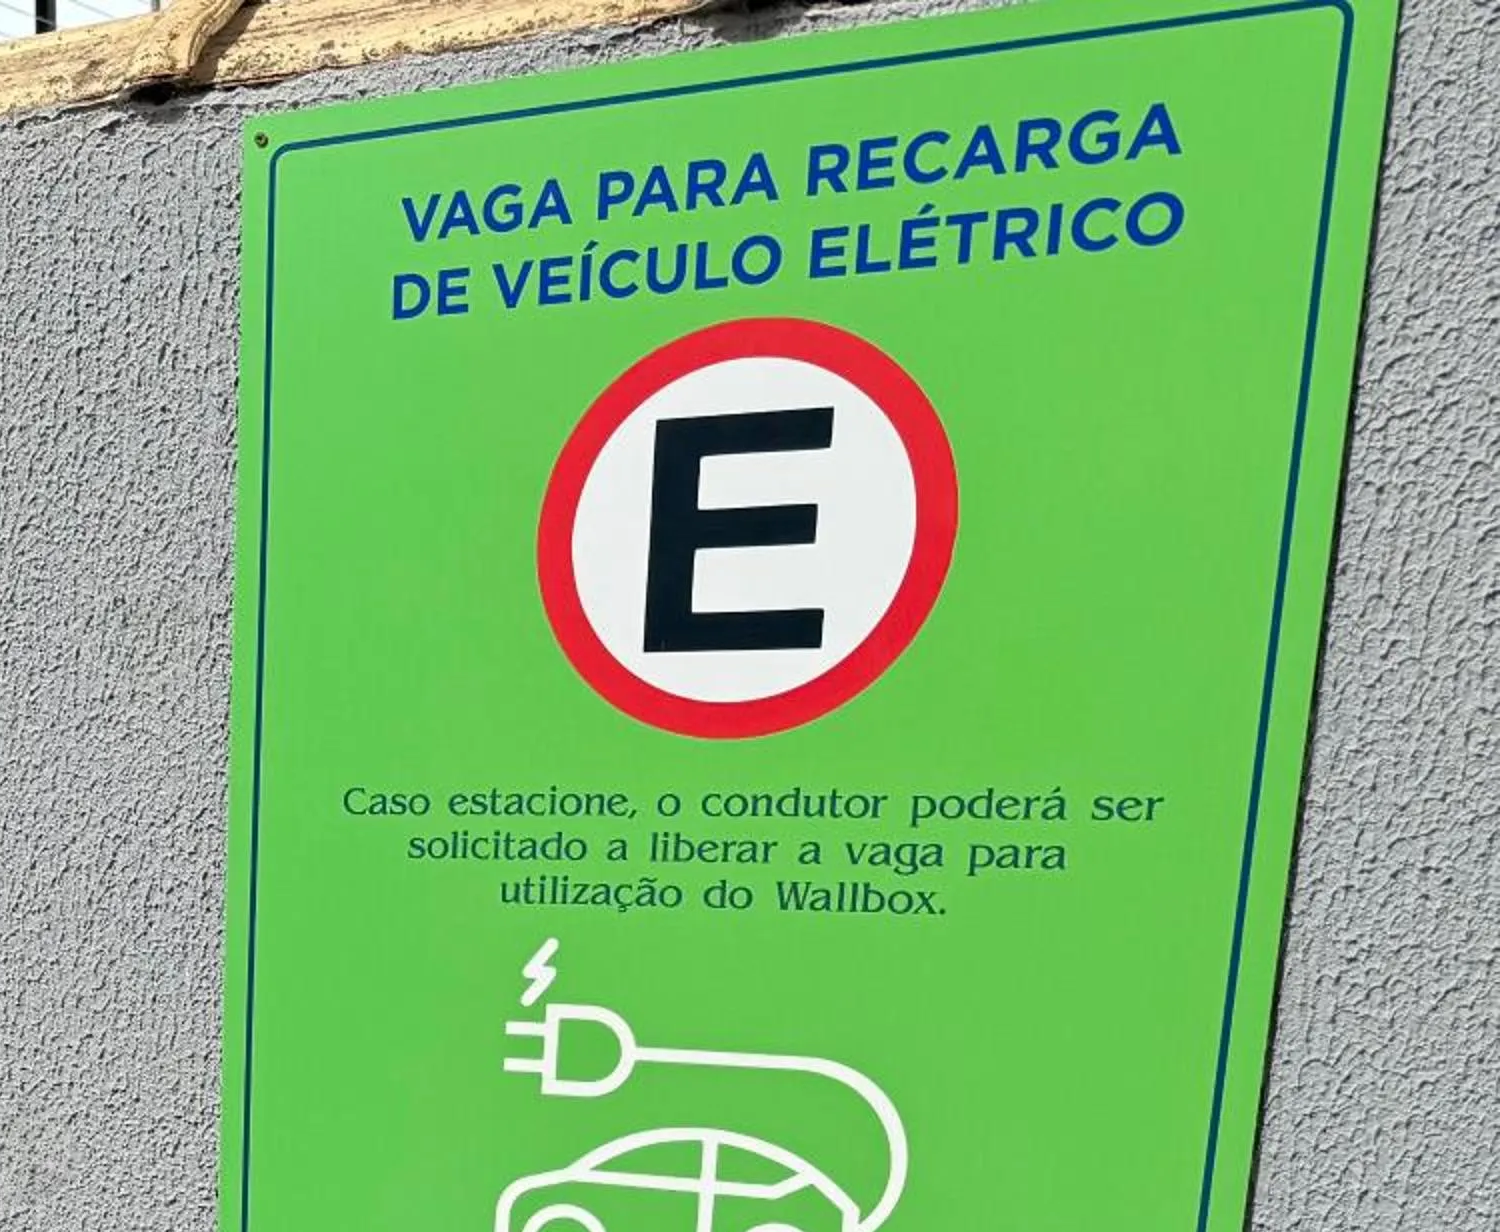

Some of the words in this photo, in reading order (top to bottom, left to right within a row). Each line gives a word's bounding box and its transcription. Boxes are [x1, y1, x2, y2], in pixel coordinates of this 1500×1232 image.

[401, 178, 573, 242] VAGA
[597, 152, 779, 221] PARA
[806, 103, 1181, 196] RECARGA
[393, 267, 470, 320] DE
[492, 235, 782, 309] VEÍCULO
[809, 191, 1185, 279] ELÉTRICO
[643, 407, 835, 653] E
[343, 787, 431, 815] Caso
[448, 785, 637, 819] estacione,
[657, 793, 681, 817] o
[701, 787, 888, 819] condutor
[911, 786, 1065, 828] poderá
[1091, 796, 1165, 821] ser
[408, 830, 587, 861] solicitado
[607, 839, 627, 861] a
[651, 831, 778, 863] liberar
[798, 841, 821, 865] a
[846, 842, 943, 876] vaga
[967, 845, 1065, 877] para
[501, 875, 683, 913] utilização
[703, 879, 753, 909] do
[777, 881, 946, 915] Wallbox.
